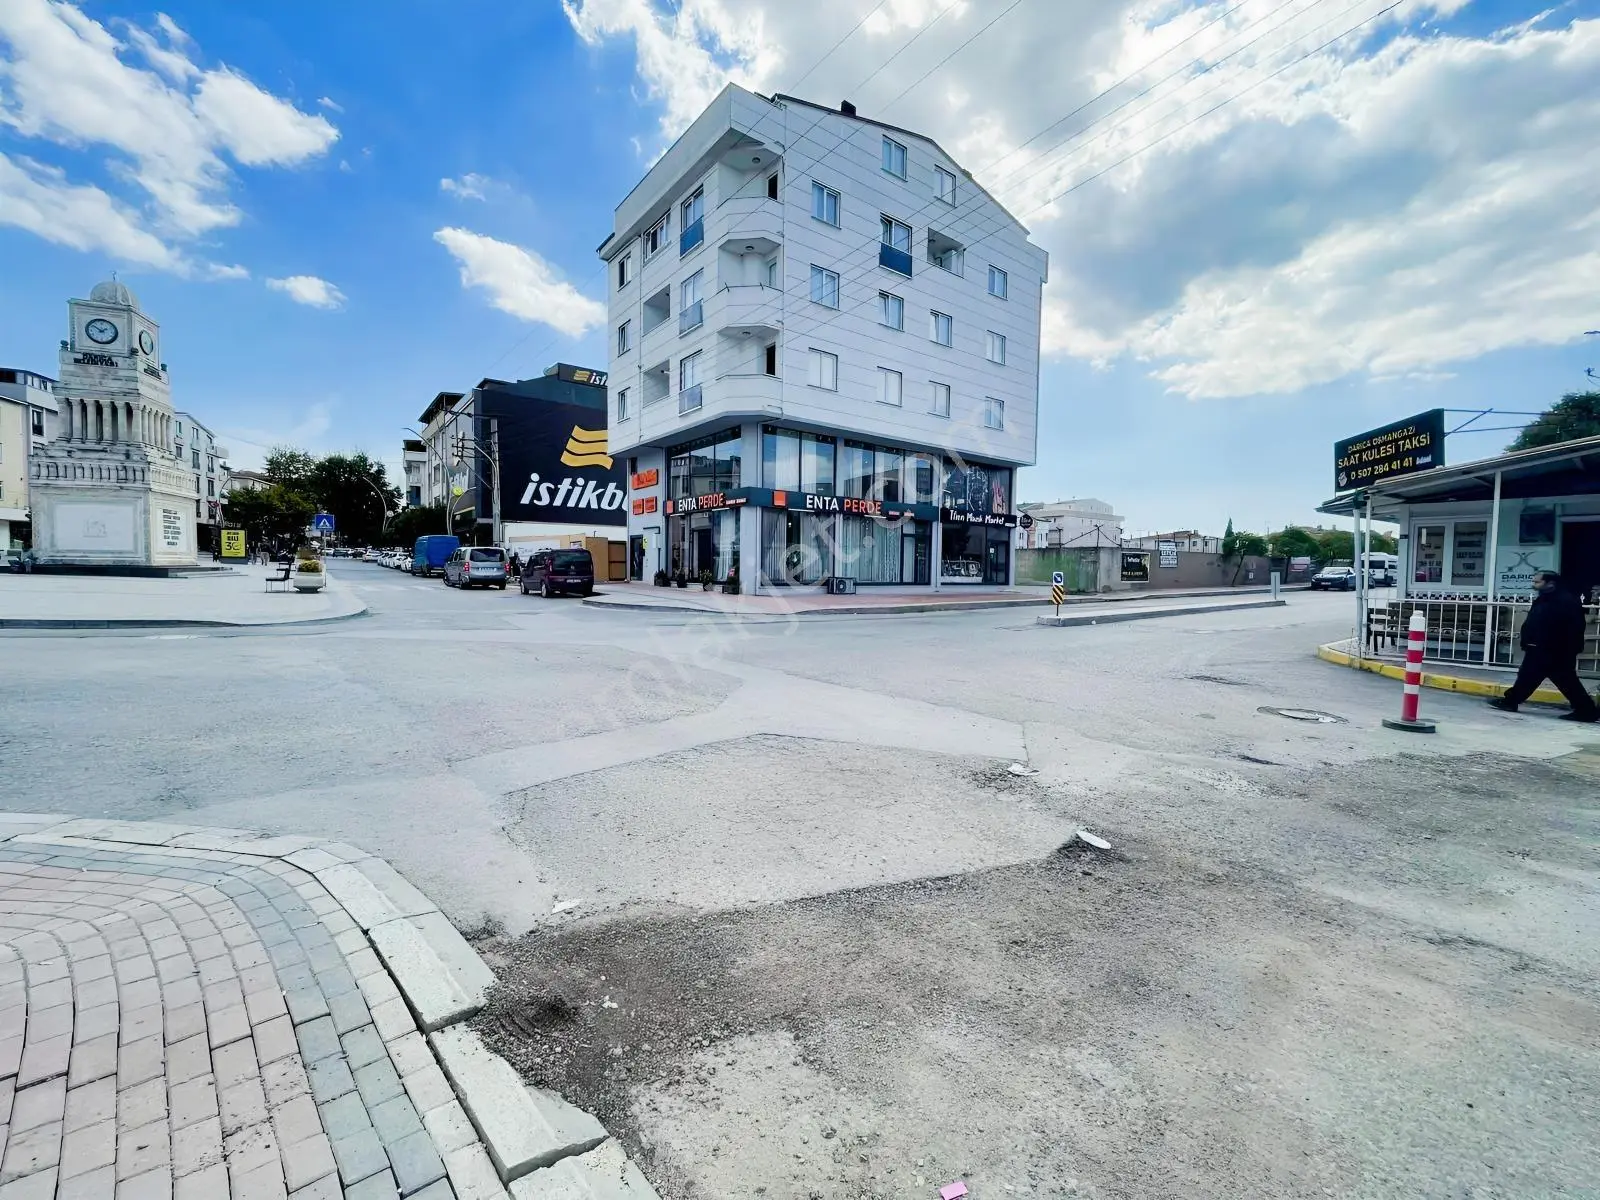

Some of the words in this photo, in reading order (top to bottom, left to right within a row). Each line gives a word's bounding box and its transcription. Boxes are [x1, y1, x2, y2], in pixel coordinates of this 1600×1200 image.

[590, 372, 608, 386] ist
[1338, 454, 1360, 468] SAAT
[1363, 443, 1396, 462] KULESİ
[1398, 432, 1430, 452] TAKSİ
[1350, 471, 1356, 480] 0
[1358, 467, 1372, 478] 507
[1373, 463, 1389, 475] 284
[1391, 460, 1401, 470] 41
[1403, 457, 1413, 467] 41
[520, 473, 627, 511] istikb
[679, 497, 697, 512] ENTA
[698, 493, 724, 509] PERDE
[806, 494, 840, 511] ENTA
[844, 499, 882, 514] PERDE
